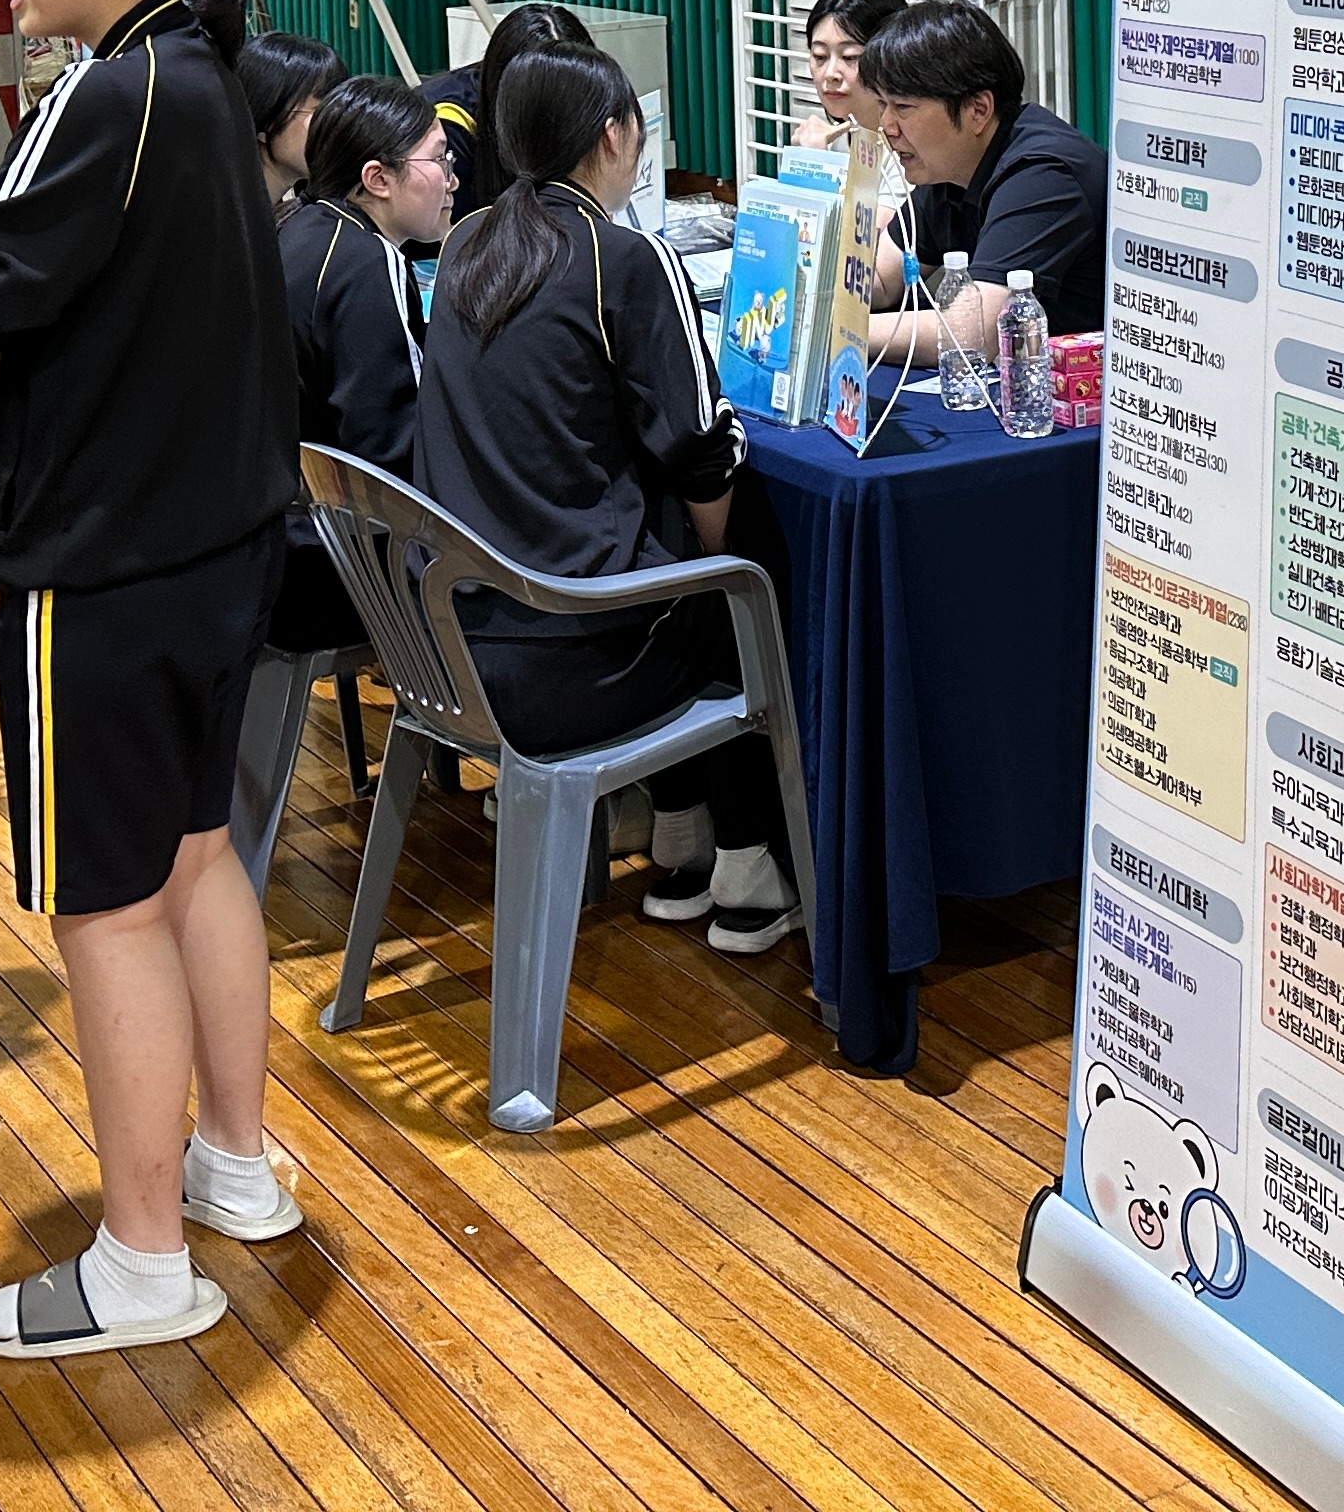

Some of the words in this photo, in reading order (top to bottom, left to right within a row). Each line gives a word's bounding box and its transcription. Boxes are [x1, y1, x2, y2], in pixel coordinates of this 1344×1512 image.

[1146, 133, 1207, 168] 간호대학
[1116, 169, 1179, 203] 간호학과(110)
[1124, 240, 1228, 289] 의생명보건대학
[1295, 259, 1344, 289] 음악학과
[1113, 282, 1198, 327] 물리치료학과(44)
[1112, 316, 1225, 370] 반려동물보건학과(43)
[1111, 350, 1182, 394] 방사선학과(30)
[1109, 386, 1217, 441] 스포츠헬스케어학부
[1290, 447, 1339, 482] 건축학과
[1108, 470, 1193, 524] 임상병리학과(42)
[1106, 504, 1192, 560] 작업치료학과(40)
[1111, 587, 1182, 636] 보건안전공학과
[1108, 664, 1147, 701] 의공학과
[1109, 638, 1169, 684] 응급구조학과
[1106, 716, 1168, 764] 의생명공학과
[1106, 742, 1202, 807] 스포츠헬스케어학부
[1092, 915, 1197, 995] 스마트물류계열(115)
[1280, 922, 1317, 960] 법학과
[1099, 954, 1140, 997] 게임학과
[1098, 983, 1174, 1044] 스마트물류학과
[1098, 1006, 1161, 1064] 컴퓨터공학과
[1097, 1034, 1184, 1105] AI소프트웨어학과
[1264, 1174, 1329, 1236] (이공계열)
